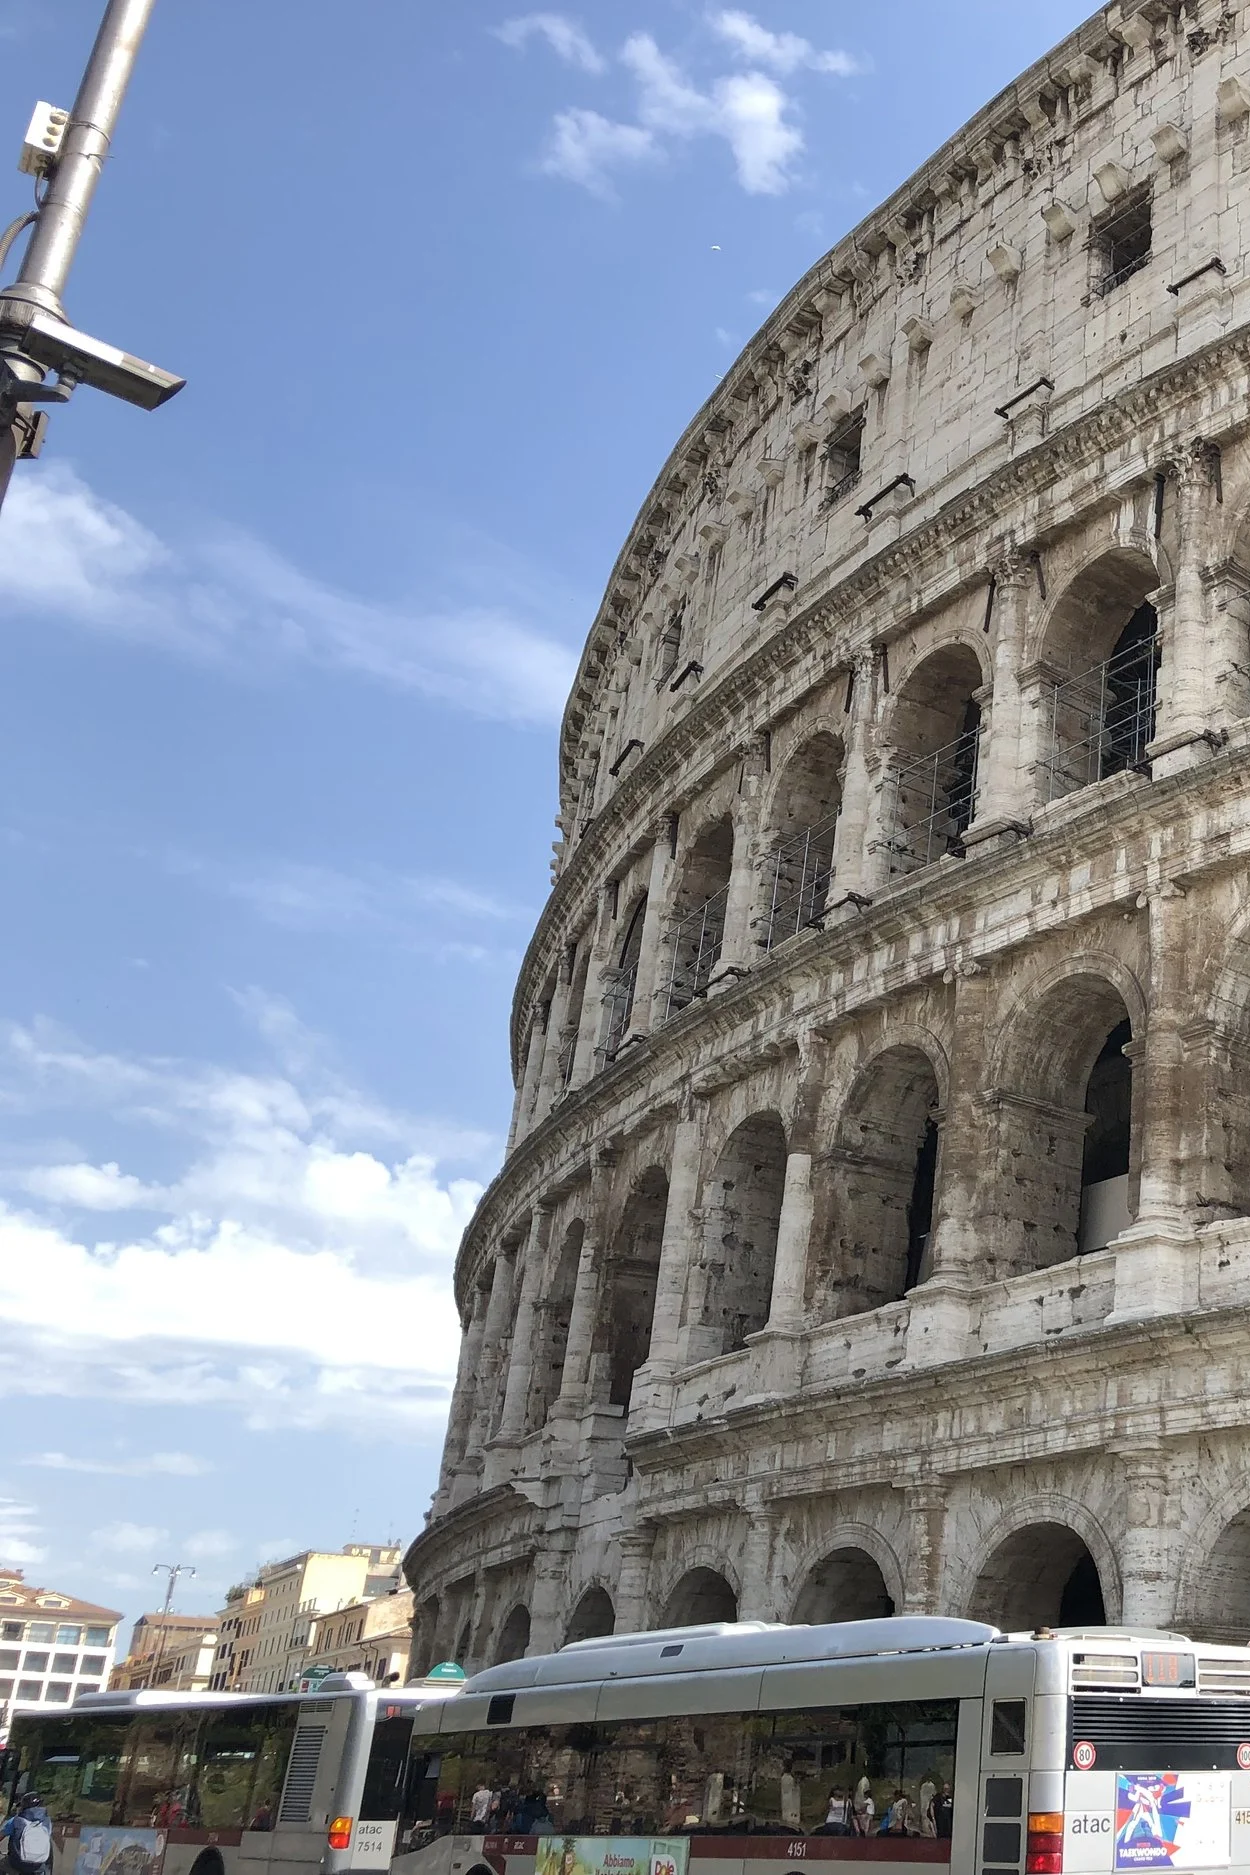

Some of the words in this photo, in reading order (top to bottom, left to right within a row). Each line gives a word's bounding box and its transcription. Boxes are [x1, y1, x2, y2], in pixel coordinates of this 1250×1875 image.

[1079, 1748, 1091, 1762] 80
[358, 1825, 382, 1834] atac
[1071, 1814, 1111, 1834] atac
[358, 1841, 382, 1851] 7514
[787, 1842, 807, 1857] 4151
[1119, 1847, 1167, 1858] TAEKWONDO
[603, 1854, 635, 1868] Abbiamo
[654, 1860, 675, 1875] Dole
